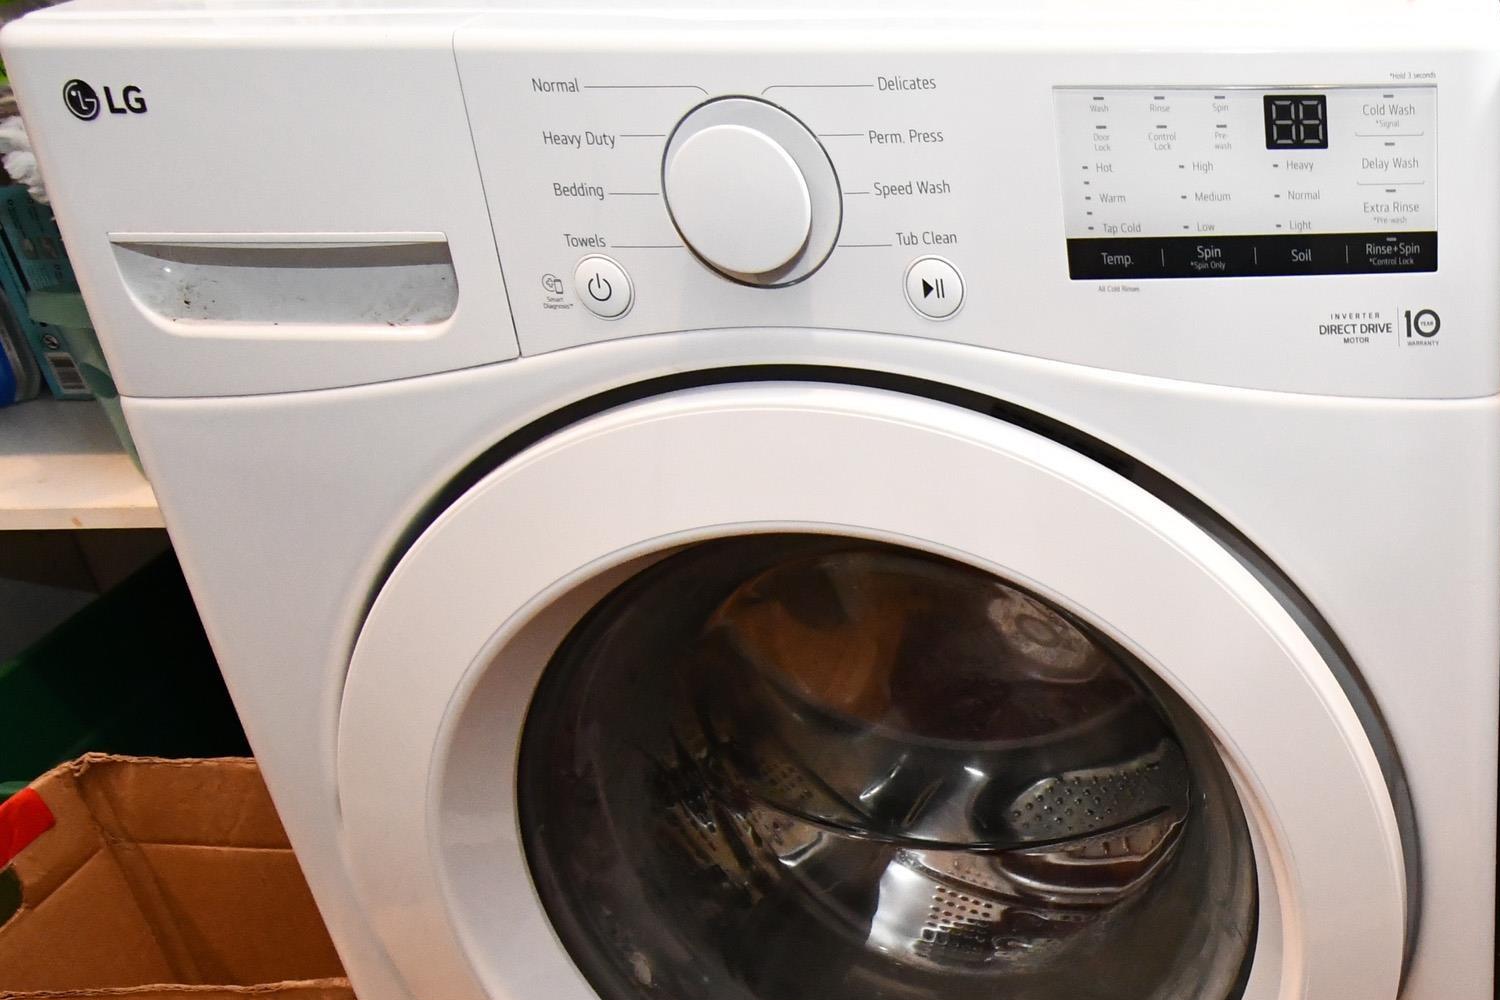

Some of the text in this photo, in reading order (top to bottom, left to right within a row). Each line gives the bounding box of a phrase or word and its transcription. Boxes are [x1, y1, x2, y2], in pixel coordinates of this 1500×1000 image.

[531, 78, 580, 93] Normal
[877, 76, 937, 91] Delicates
[103, 85, 148, 114] LG
[1089, 104, 1109, 113] Wash
[1149, 104, 1171, 112] Rinse
[1212, 102, 1229, 112] Spin
[1362, 103, 1416, 116] Cold Wash
[543, 131, 616, 149] Heavy Duty
[868, 129, 944, 144] Perm. Press
[1093, 133, 1110, 141] Door
[1148, 132, 1177, 141] Control
[1095, 143, 1111, 152] Lock
[1154, 142, 1172, 151] Lock
[1096, 163, 1113, 173] Hot
[1192, 161, 1214, 174] High
[1286, 160, 1314, 173] Heavy
[1361, 157, 1419, 172] Delay Wash
[553, 182, 605, 200] Bedding
[873, 179, 951, 199] Speed Wash
[1099, 193, 1126, 203] Warm
[1194, 191, 1232, 202] Medium
[1287, 190, 1321, 201] Normal
[1363, 202, 1420, 213] Extra Rinse
[1103, 223, 1142, 235] Tap Cold
[1197, 222, 1215, 232] Low
[1289, 220, 1312, 231] Light
[563, 233, 607, 248] Towels
[896, 231, 958, 246] Tub Clean
[1196, 245, 1222, 260] Spin
[1291, 248, 1312, 262] Soil
[1101, 252, 1134, 267] Temp.
[1210, 260, 1226, 270] Only
[1398, 256, 1414, 265] Lock
[1330, 312, 1381, 320] INVERTER
[1319, 322, 1393, 336] DIRECT DRIVE
[1404, 308, 1441, 338] 10
[1343, 336, 1370, 344] MOTOR
